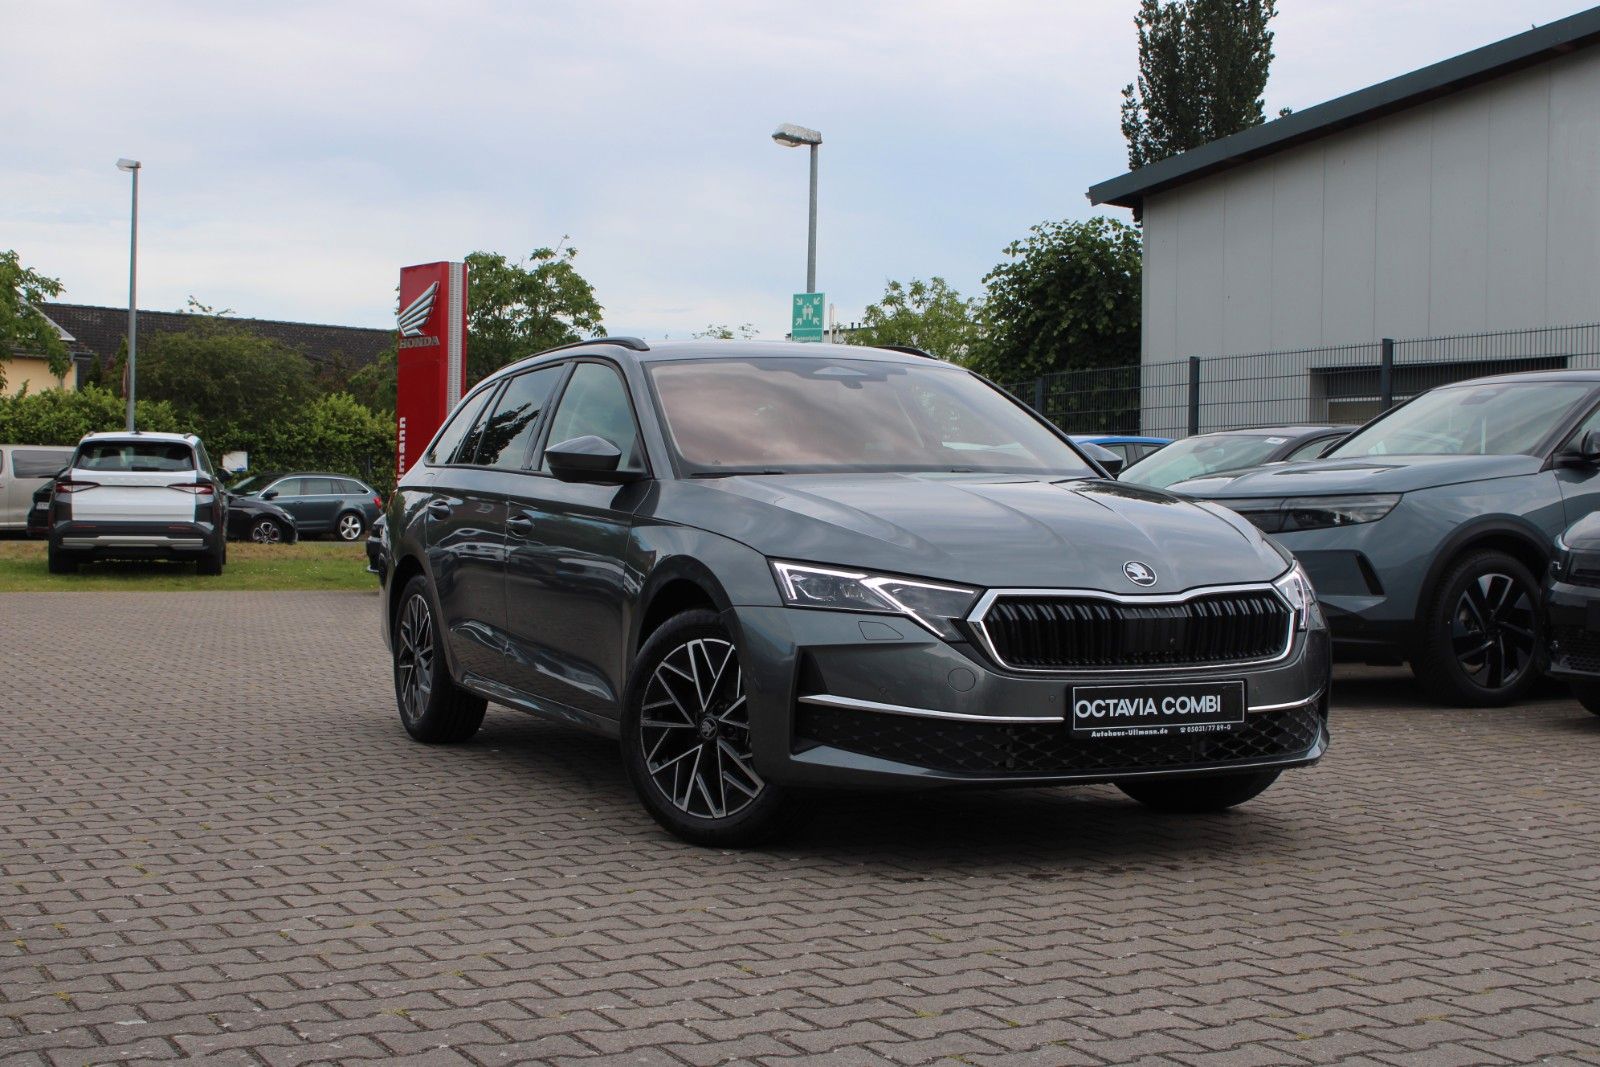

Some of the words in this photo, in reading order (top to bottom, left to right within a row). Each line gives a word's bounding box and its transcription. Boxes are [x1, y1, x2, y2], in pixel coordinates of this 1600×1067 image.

[399, 336, 440, 349] HONDA
[1075, 698, 1158, 718] OCTAVIA
[1161, 695, 1221, 715] COMBI
[1091, 728, 1169, 738] Autohaus-Ullmann.de
